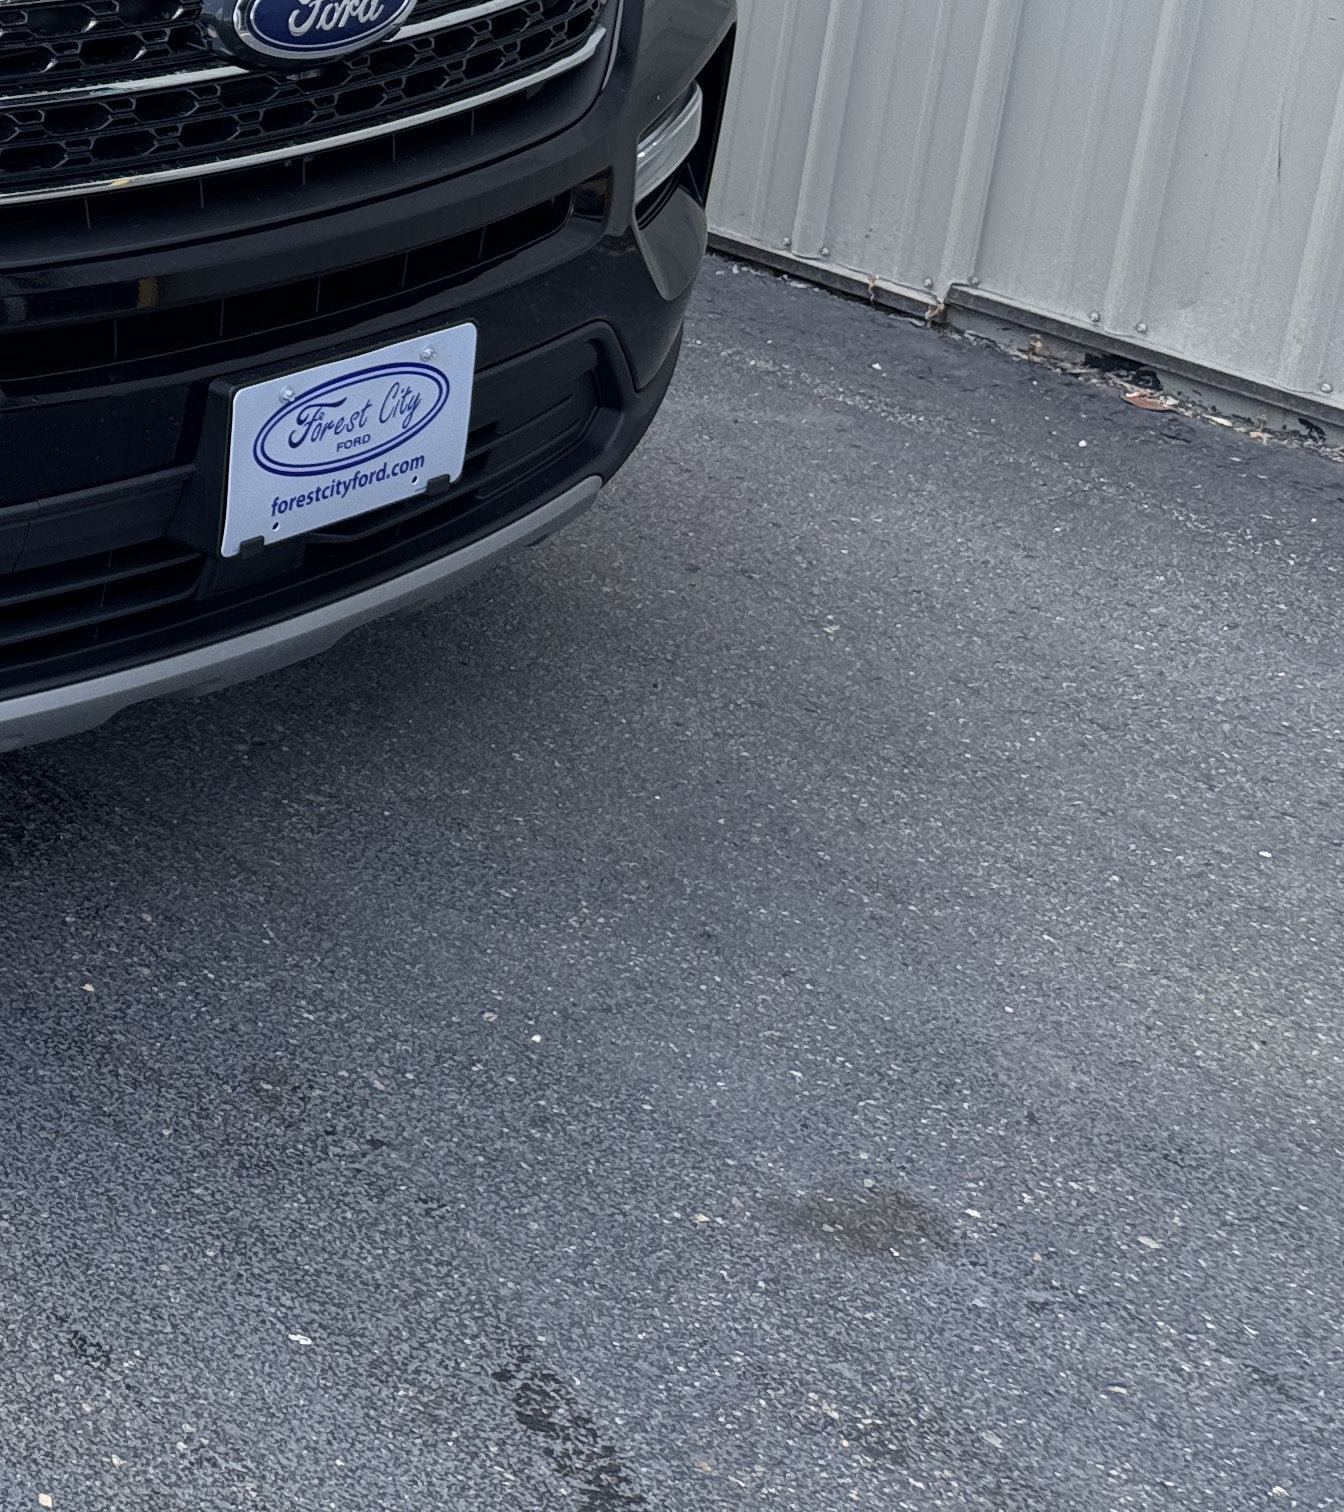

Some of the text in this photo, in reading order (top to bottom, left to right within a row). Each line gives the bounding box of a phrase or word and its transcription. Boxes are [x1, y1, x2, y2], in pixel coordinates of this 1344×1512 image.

[288, 381, 422, 449] Forest City
[336, 433, 372, 453] FORD
[271, 454, 426, 516] forestcityford.com
